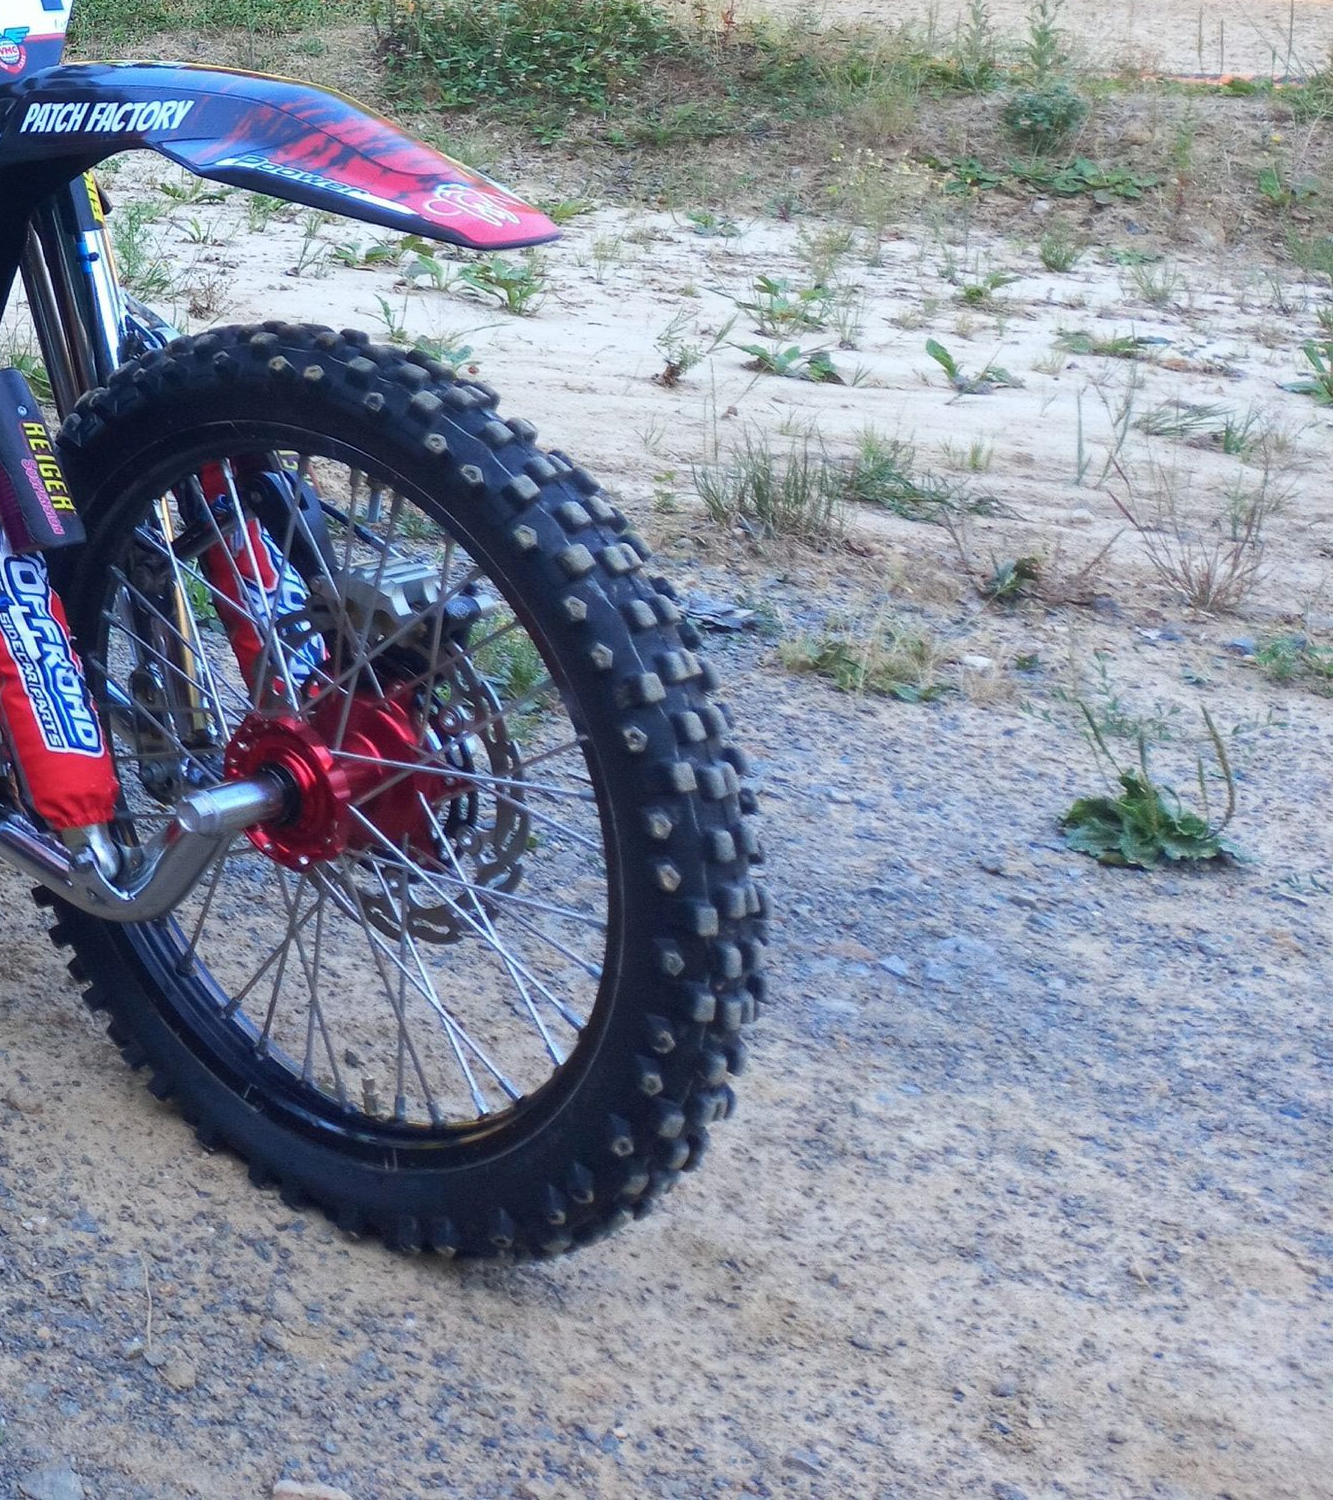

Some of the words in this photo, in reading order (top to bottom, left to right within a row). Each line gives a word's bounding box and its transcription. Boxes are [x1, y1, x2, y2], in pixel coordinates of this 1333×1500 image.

[20, 101, 87, 134] PATCH
[88, 98, 195, 133] FACTORY
[21, 421, 77, 512] REIGER
[34, 682, 66, 749] PARTS
